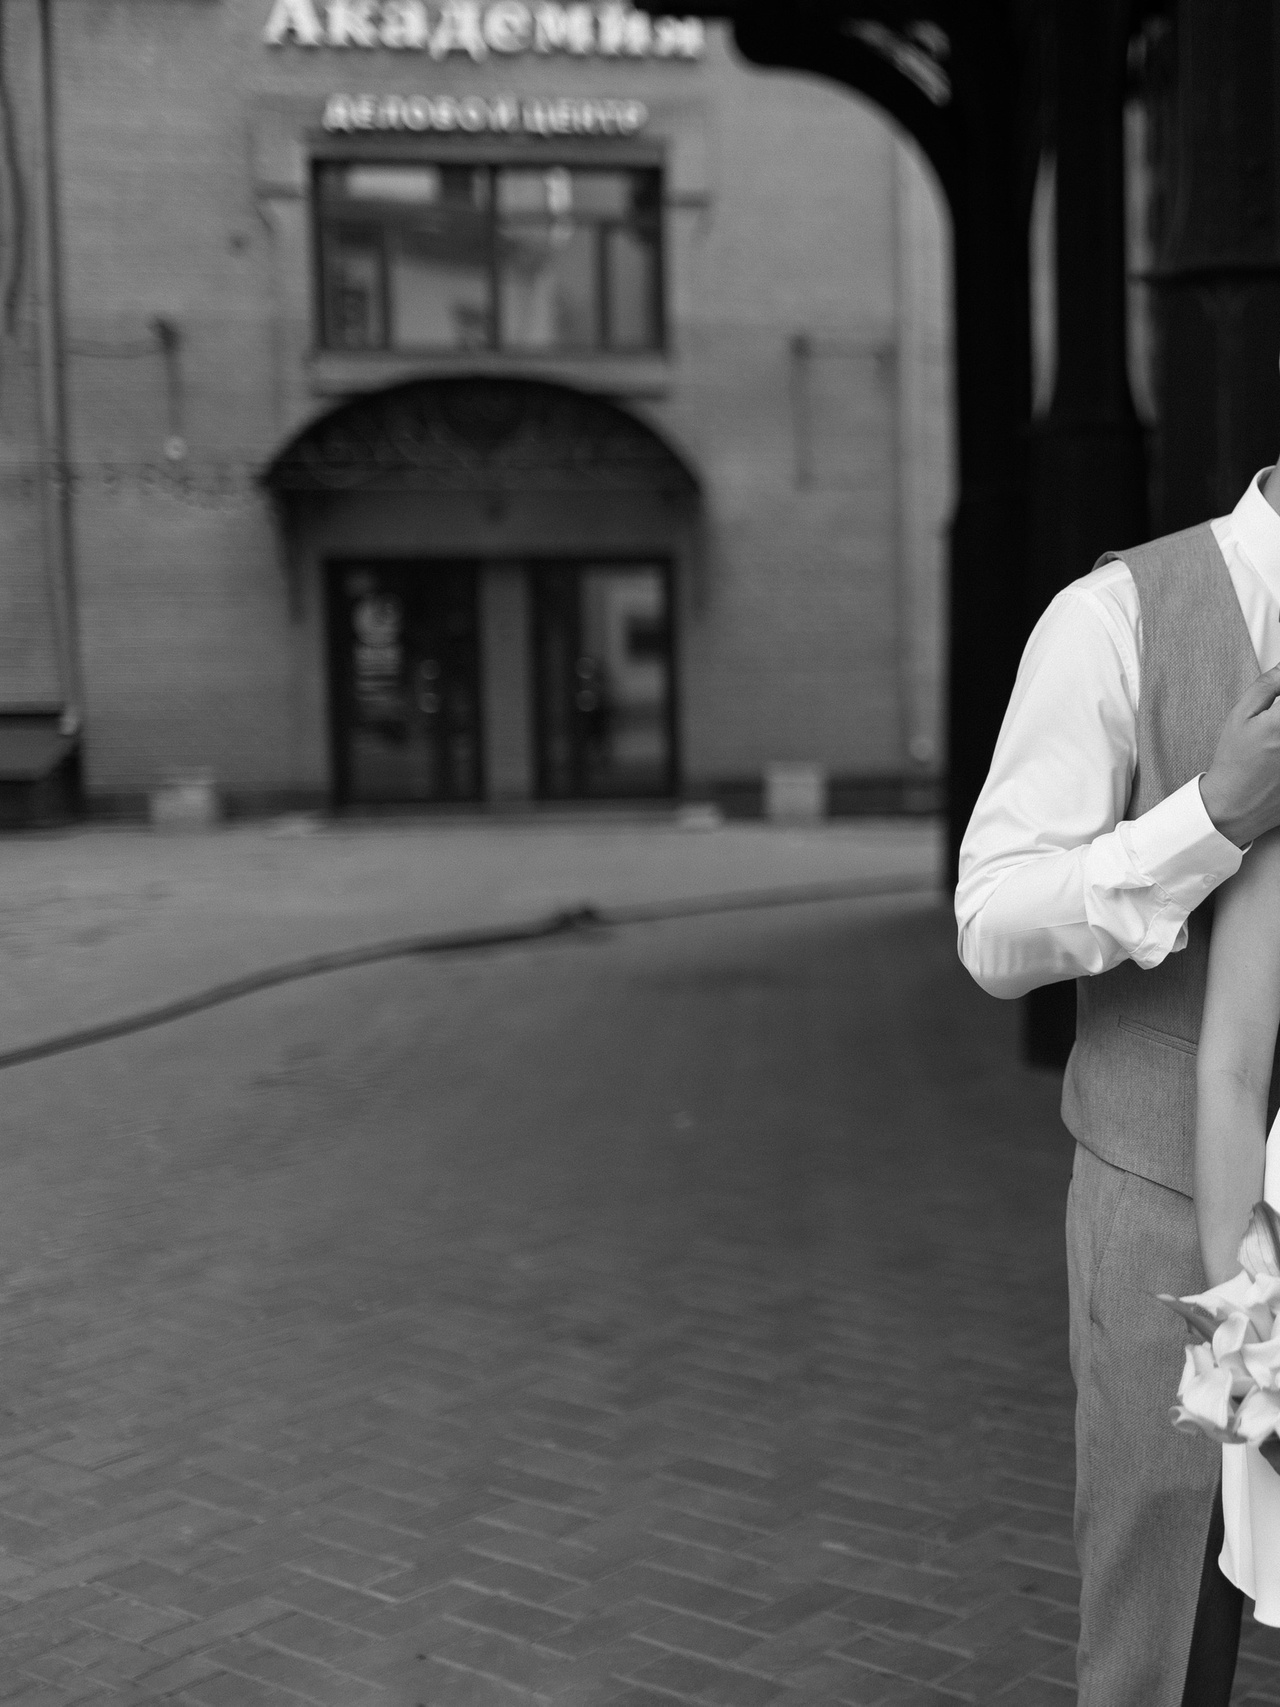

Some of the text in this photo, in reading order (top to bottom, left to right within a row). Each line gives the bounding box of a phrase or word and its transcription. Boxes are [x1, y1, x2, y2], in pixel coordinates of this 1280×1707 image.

[263, 0, 704, 62] Академия
[322, 94, 648, 136] ДЕЛОВОЙ ЦЕНТР
